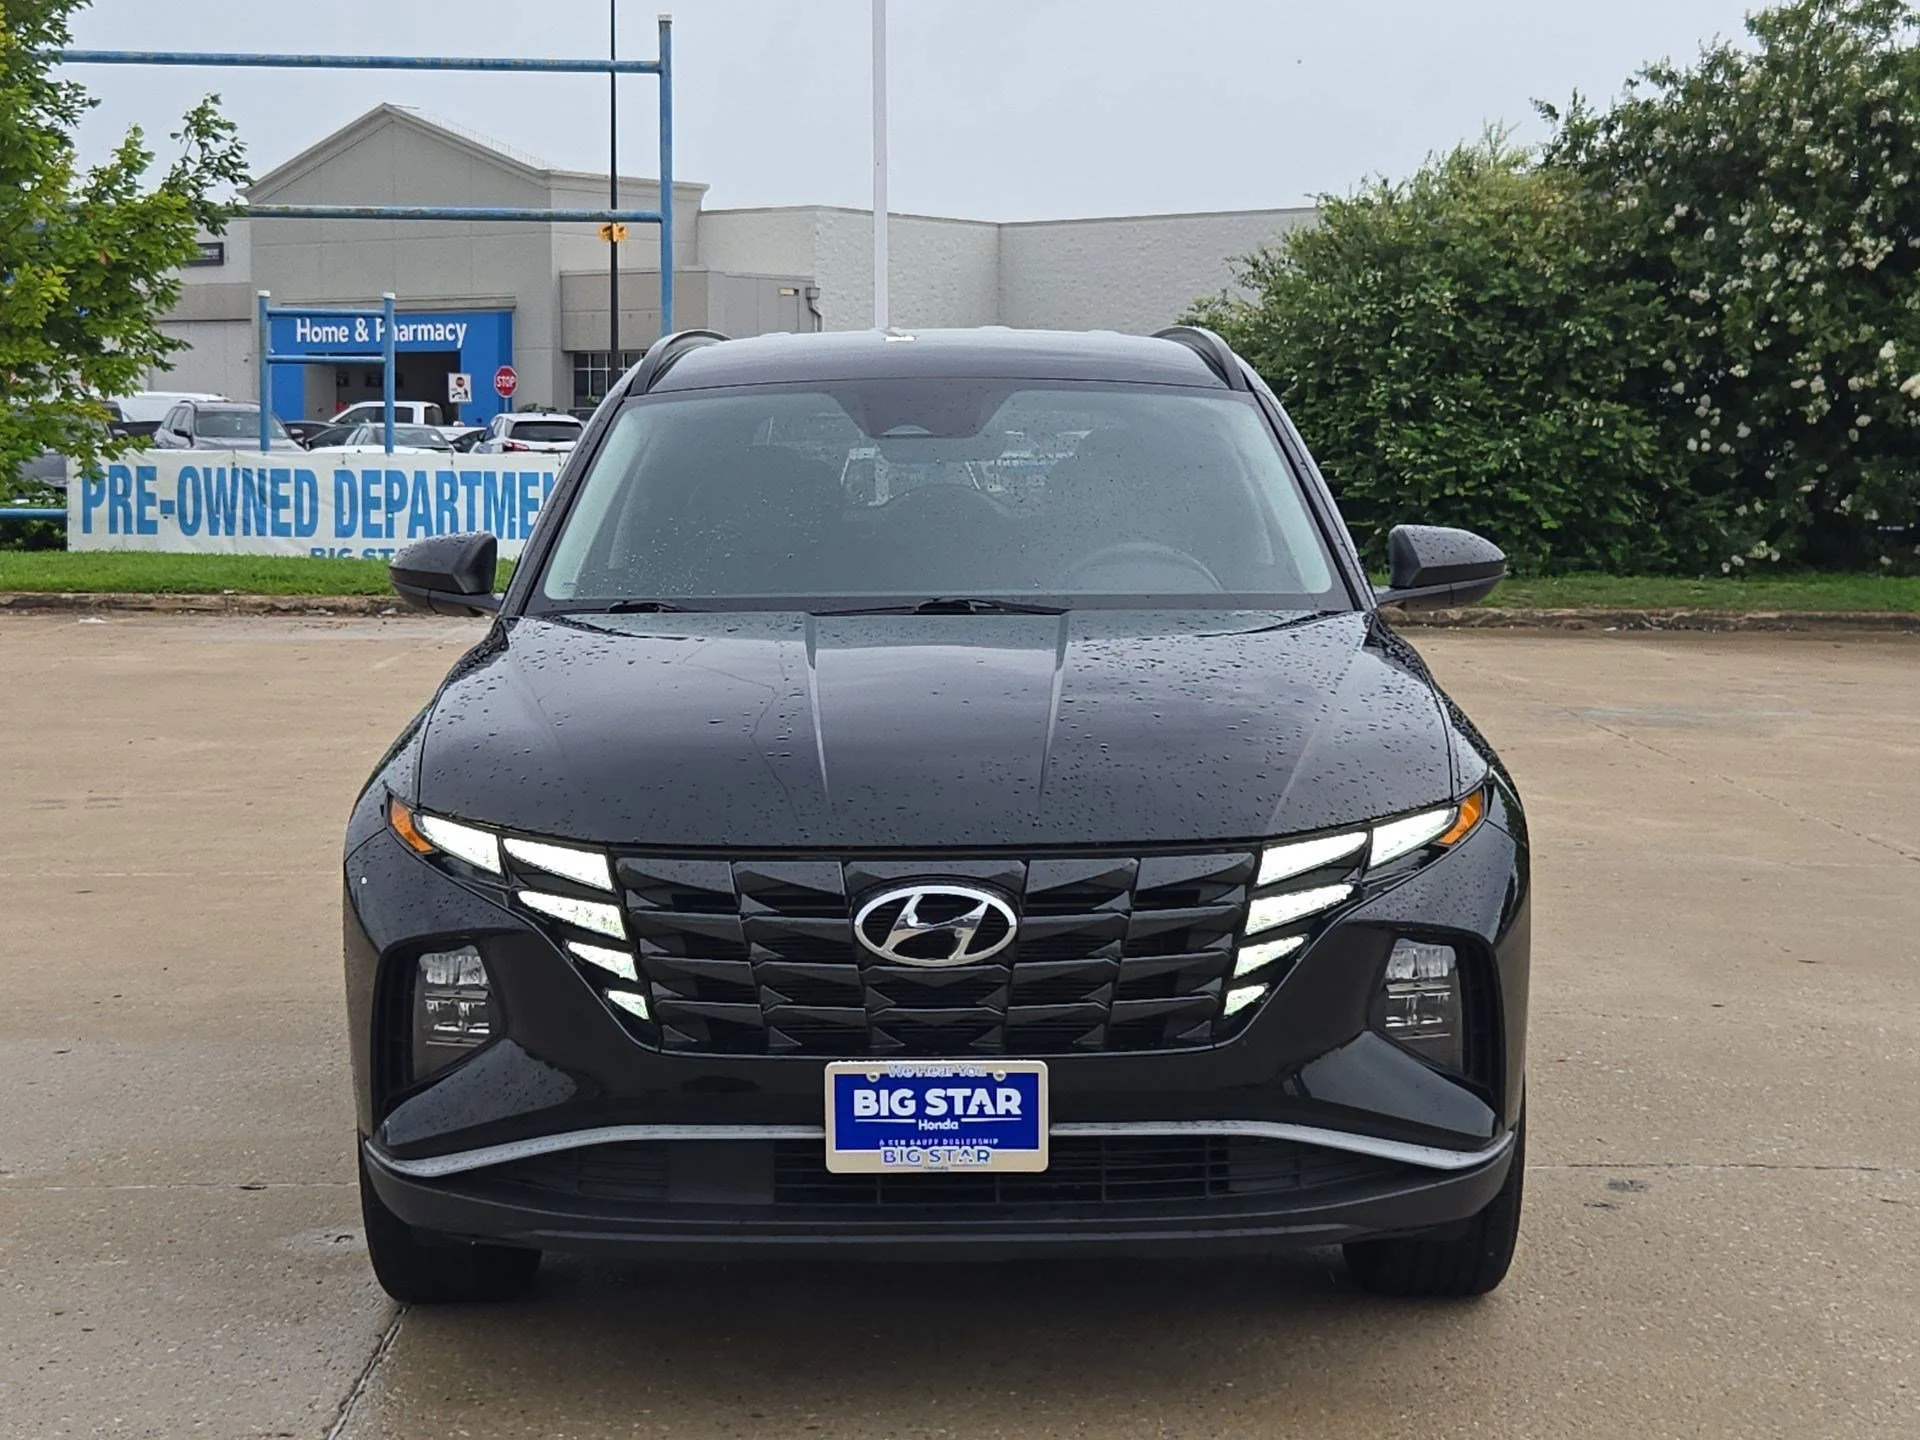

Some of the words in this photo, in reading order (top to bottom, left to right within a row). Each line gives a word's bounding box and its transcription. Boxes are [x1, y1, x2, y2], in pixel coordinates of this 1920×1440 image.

[296, 317, 349, 343] Home
[354, 316, 370, 342] &
[496, 375, 515, 388] STOP
[82, 464, 319, 538] PRE-OWNED
[853, 1089, 916, 1117] BIG
[924, 1088, 1022, 1116] STAR
[918, 1119, 959, 1131] Honda
[883, 1149, 921, 1163] BIG
[928, 1148, 991, 1162] STAR
